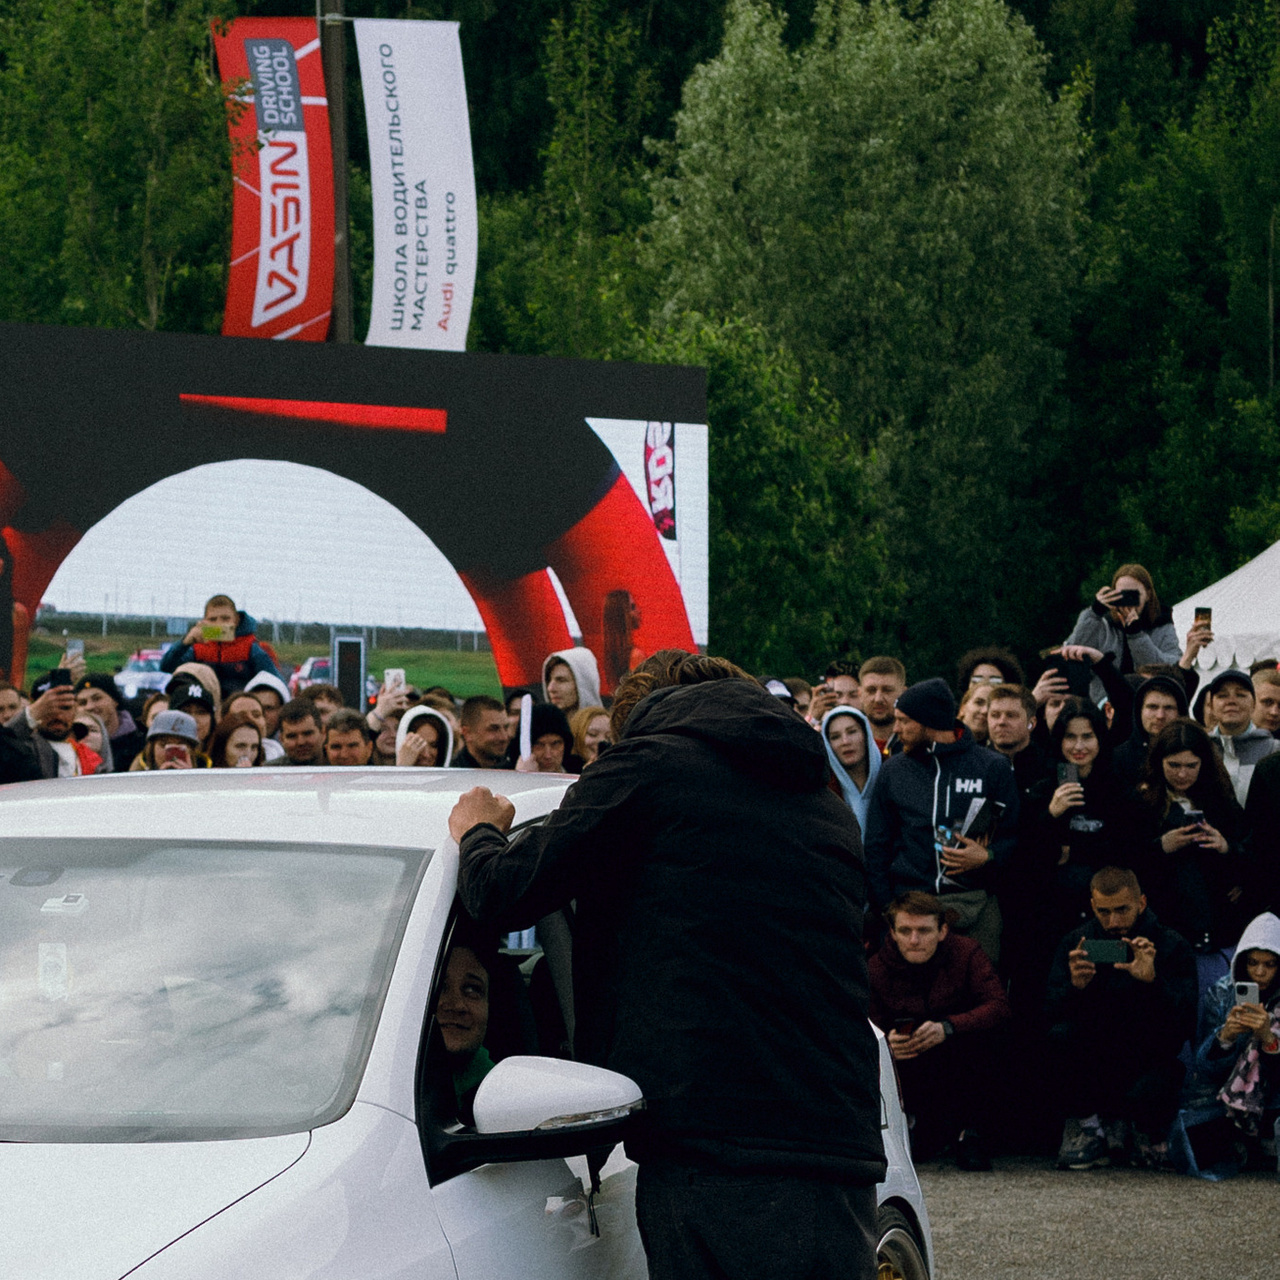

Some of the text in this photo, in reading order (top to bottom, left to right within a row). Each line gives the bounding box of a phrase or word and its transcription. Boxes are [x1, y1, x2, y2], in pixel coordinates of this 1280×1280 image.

[252, 45, 280, 124] DRIVING
[272, 46, 297, 125] SCHOOL
[263, 141, 301, 312] VASIN
[379, 43, 409, 331] ШКОЛА ВОДИТЕЛЬСКОГО
[410, 179, 429, 331] МАСТЕРСТВА
[437, 191, 458, 331] Audi quattro
